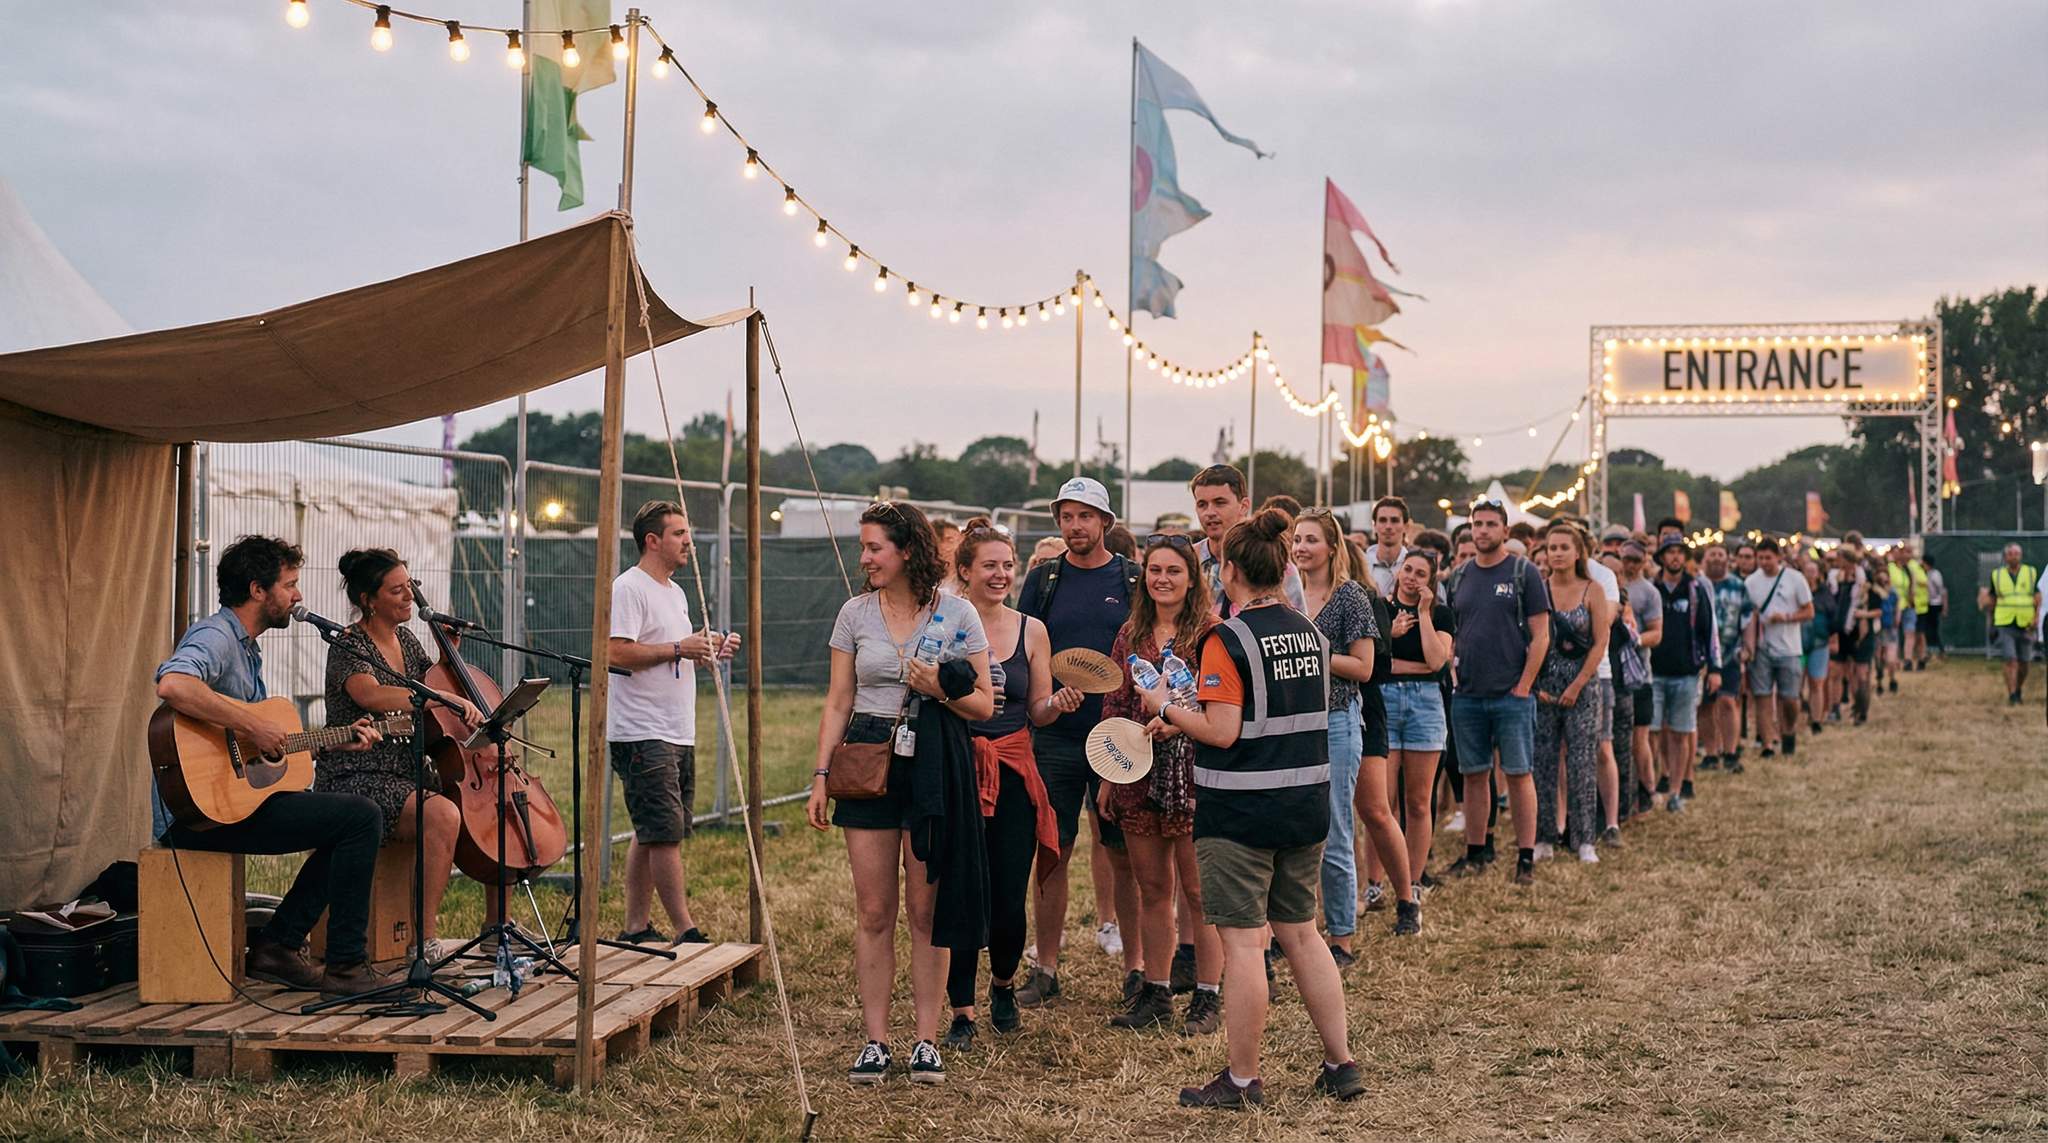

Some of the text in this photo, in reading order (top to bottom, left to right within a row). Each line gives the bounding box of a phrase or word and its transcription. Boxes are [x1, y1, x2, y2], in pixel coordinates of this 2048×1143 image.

[1664, 348, 1863, 390] ENTRANCE
[1260, 632, 1320, 657] FESTIVAL
[1273, 655, 1320, 680] HELPER
